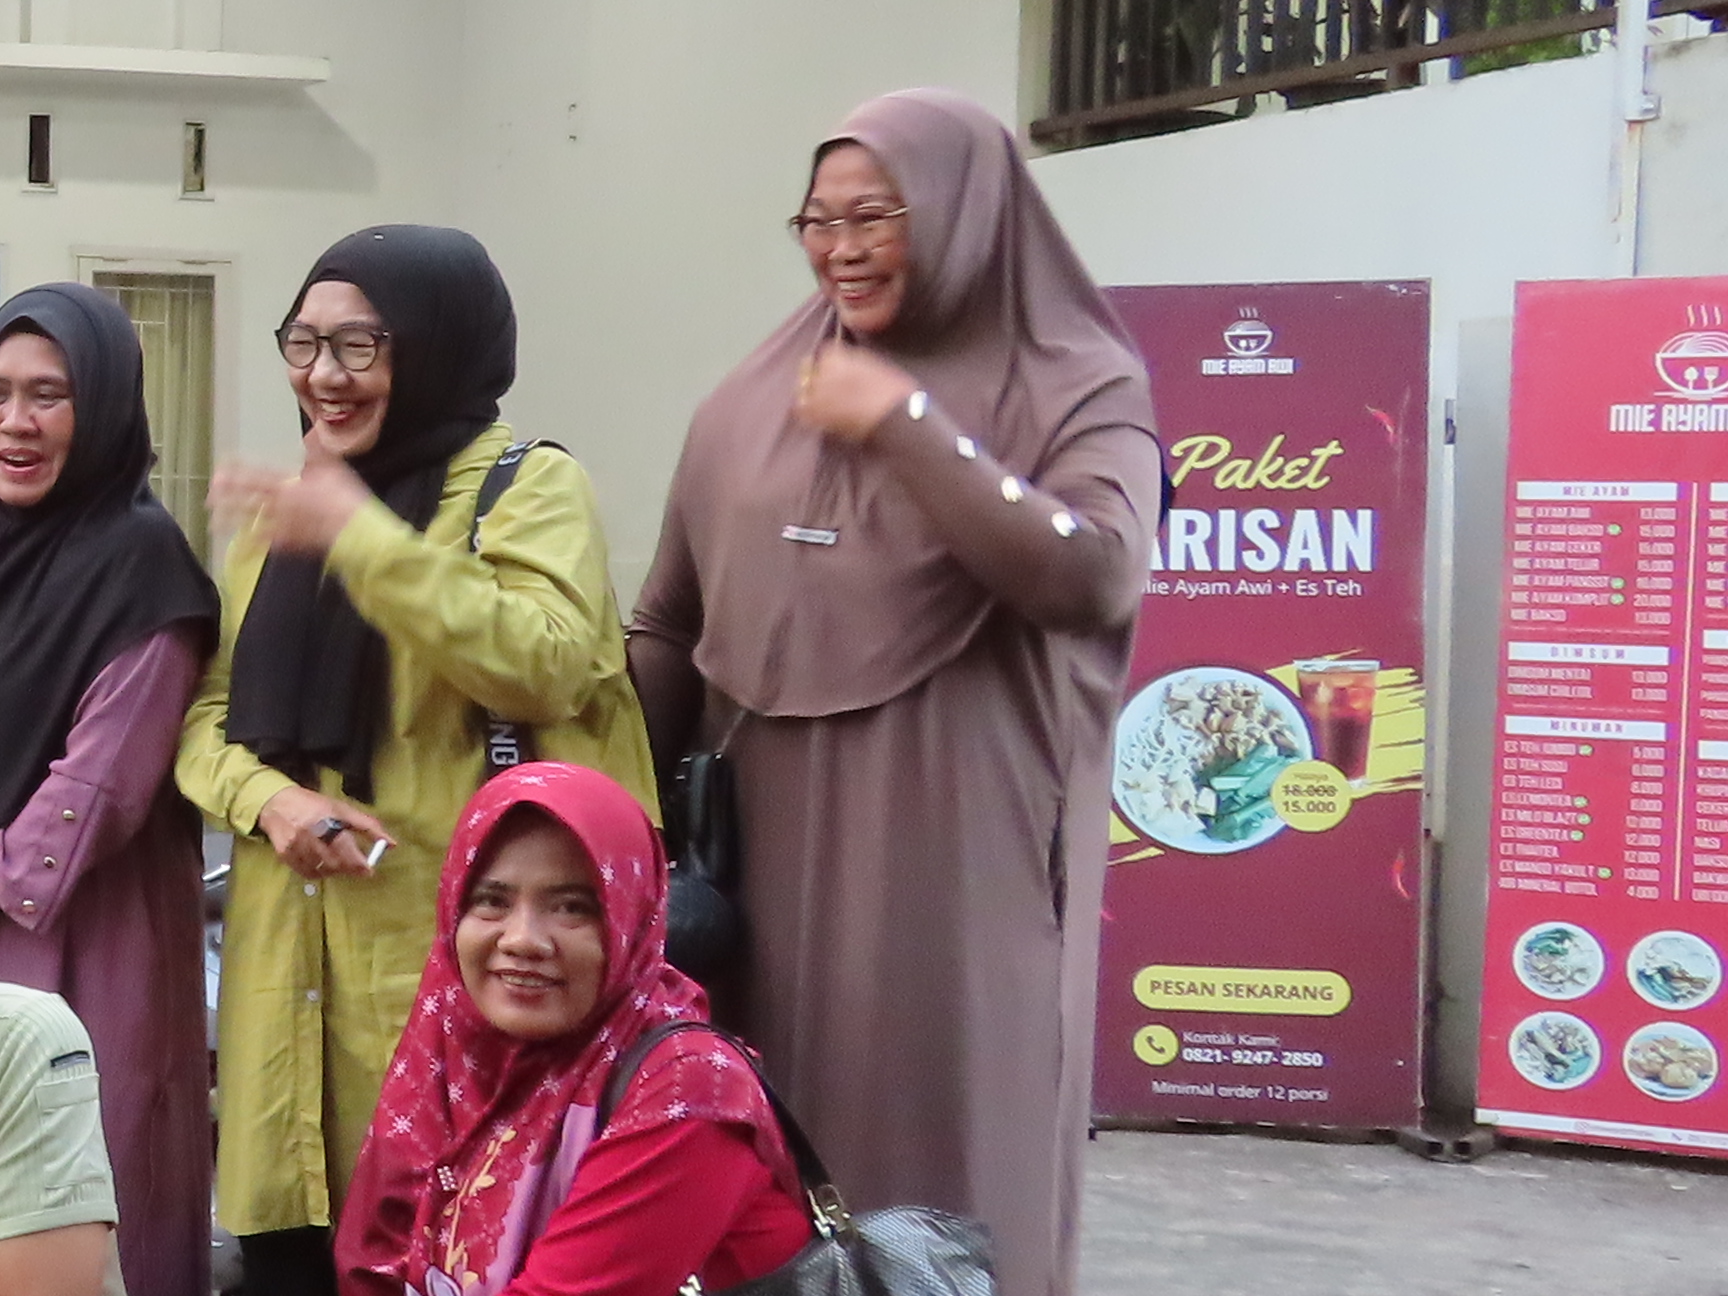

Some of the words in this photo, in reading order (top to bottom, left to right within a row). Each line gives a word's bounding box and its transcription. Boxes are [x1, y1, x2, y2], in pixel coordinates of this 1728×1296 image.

[1609, 404, 1656, 432] MIE
[1170, 433, 1344, 489] Paket
[1173, 579, 1231, 599] Ayam
[1234, 579, 1272, 595] Awi
[1295, 580, 1318, 596] Es
[1324, 580, 1362, 596] Teh
[1282, 800, 1336, 813] 15.000
[1150, 979, 1215, 997] PESAN
[1222, 983, 1334, 1002] SEKARANG
[1281, 1052, 1324, 1067] 2850
[1218, 1085, 1261, 1099] order
[1266, 1086, 1286, 1099] 12
